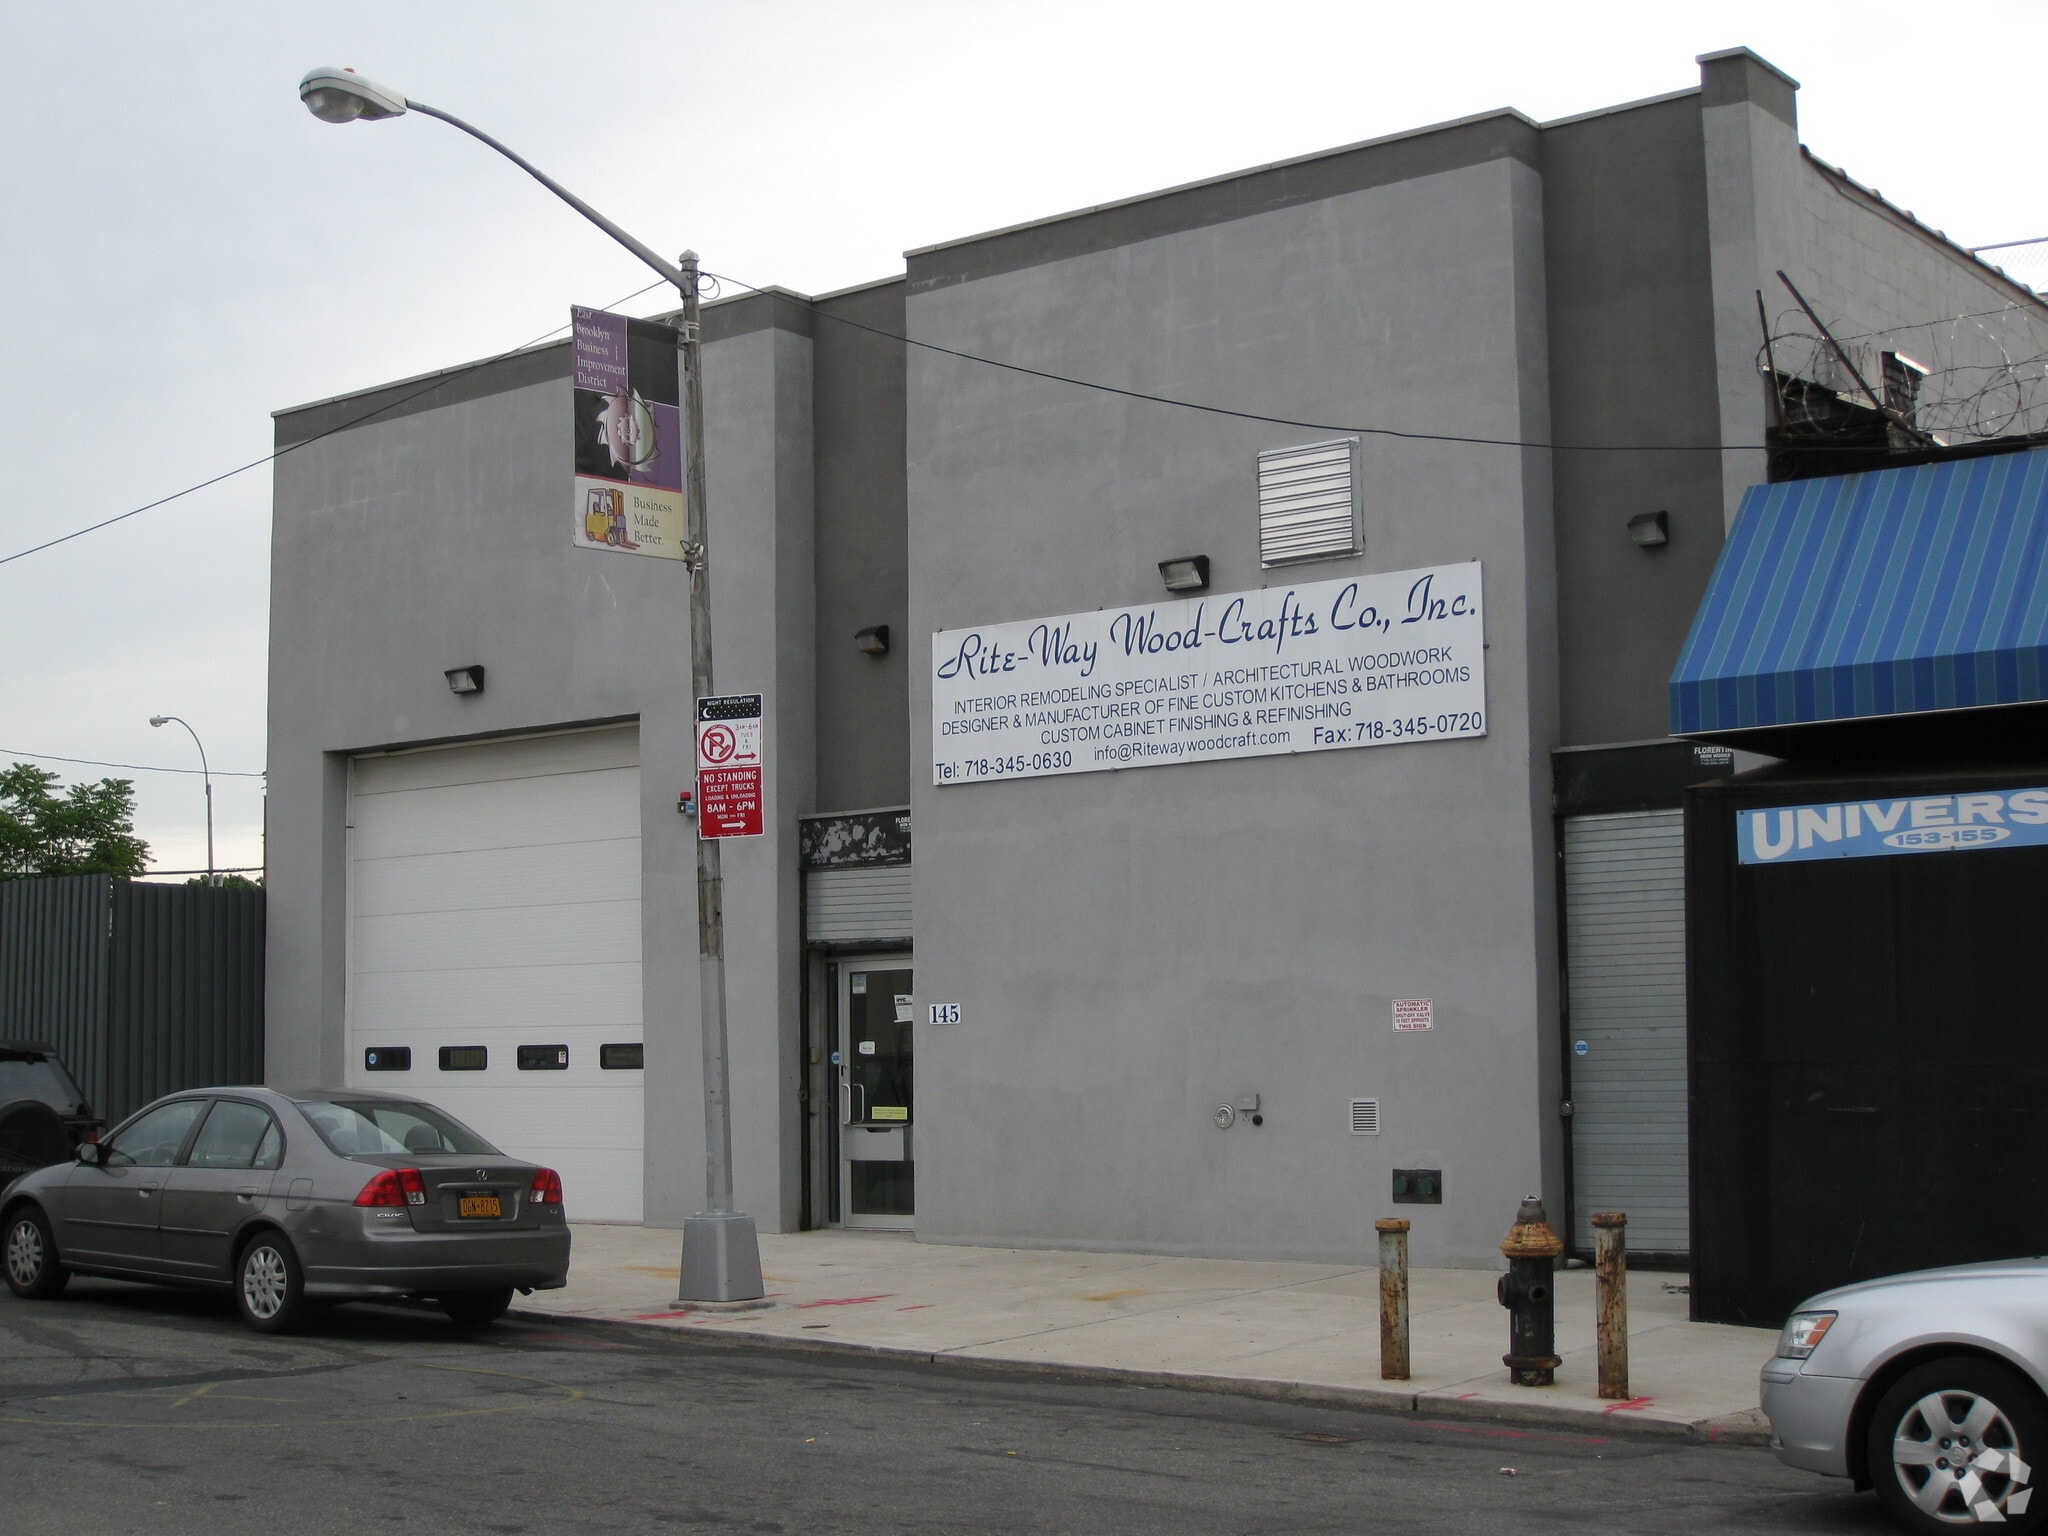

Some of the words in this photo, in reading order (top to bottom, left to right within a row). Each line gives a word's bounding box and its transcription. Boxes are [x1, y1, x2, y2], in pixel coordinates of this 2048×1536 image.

[576, 307, 593, 320] East
[575, 323, 611, 342] Brooklyn
[577, 339, 609, 356] Business
[577, 355, 626, 376] Improvement
[577, 371, 607, 388] District
[633, 496, 673, 512] Business
[634, 513, 660, 528] Made
[936, 621, 1098, 681] Rite-Way
[1109, 591, 1320, 656] Wood-Crafts
[1401, 574, 1476, 625] Inc.
[954, 694, 1017, 714] INTERIOR
[1020, 684, 1112, 707] REMODELING
[1115, 673, 1199, 697] SPECIALIST
[1213, 658, 1344, 687] ARCHITECTURAL
[1348, 646, 1453, 672] WOODWORK
[942, 715, 1009, 736] DESIGNER
[1012, 714, 1022, 728] &
[1025, 701, 1140, 727] MANUFACTURER
[1144, 698, 1165, 714] OF
[1168, 695, 1199, 712] FINE
[1202, 688, 1267, 708] CUSTOM
[1270, 679, 1348, 701] KITCHENS
[1351, 677, 1362, 693] &
[1366, 666, 1471, 691] BATHROOMS
[1041, 726, 1100, 745] CUSTOM
[1103, 719, 1165, 739] CABINET
[1169, 712, 1239, 732] FINISHING
[1242, 710, 1252, 726] &
[1256, 701, 1352, 724] REFINISHING
[935, 762, 960, 779] Tel:
[965, 750, 1072, 777] 718-345-0630
[1094, 730, 1291, 762] info@Ritewaywoodcraft.com
[1313, 726, 1352, 745] Fax:
[1355, 711, 1482, 741] 718-345-0720
[703, 774, 715, 784] NO
[717, 770, 757, 782] STANDING
[706, 784, 728, 793] EXCEPT
[731, 782, 755, 791] TRUCKS
[706, 803, 726, 813] 8AM
[736, 800, 756, 811] 6PM
[1751, 791, 2048, 861] UNIVERS
[1896, 828, 1998, 847] 153-155
[931, 1004, 960, 1024] 145
